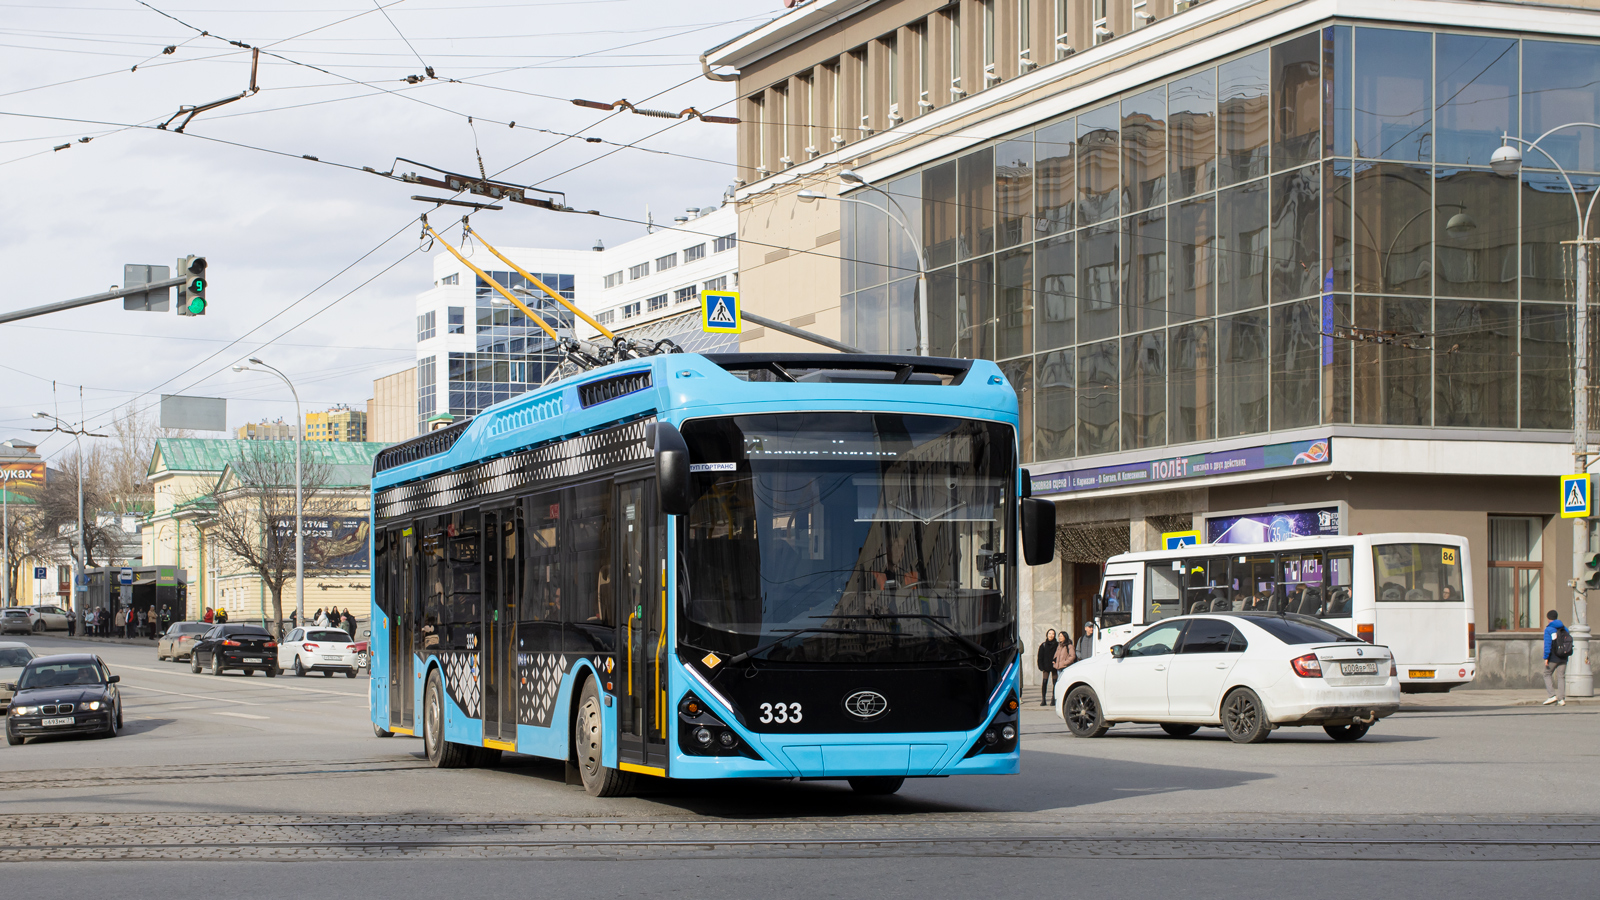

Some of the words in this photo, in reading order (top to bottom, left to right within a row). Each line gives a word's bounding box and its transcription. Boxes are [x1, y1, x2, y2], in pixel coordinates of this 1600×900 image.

[196, 280, 203, 292] 9
[1152, 457, 1188, 479] ПОЛЁТ
[1223, 458, 1247, 470] действиях
[1052, 478, 1067, 490] сцена
[1272, 526, 1281, 543] 35
[1442, 551, 1454, 562] 86
[466, 633, 475, 650] 333
[759, 701, 803, 724] 333
